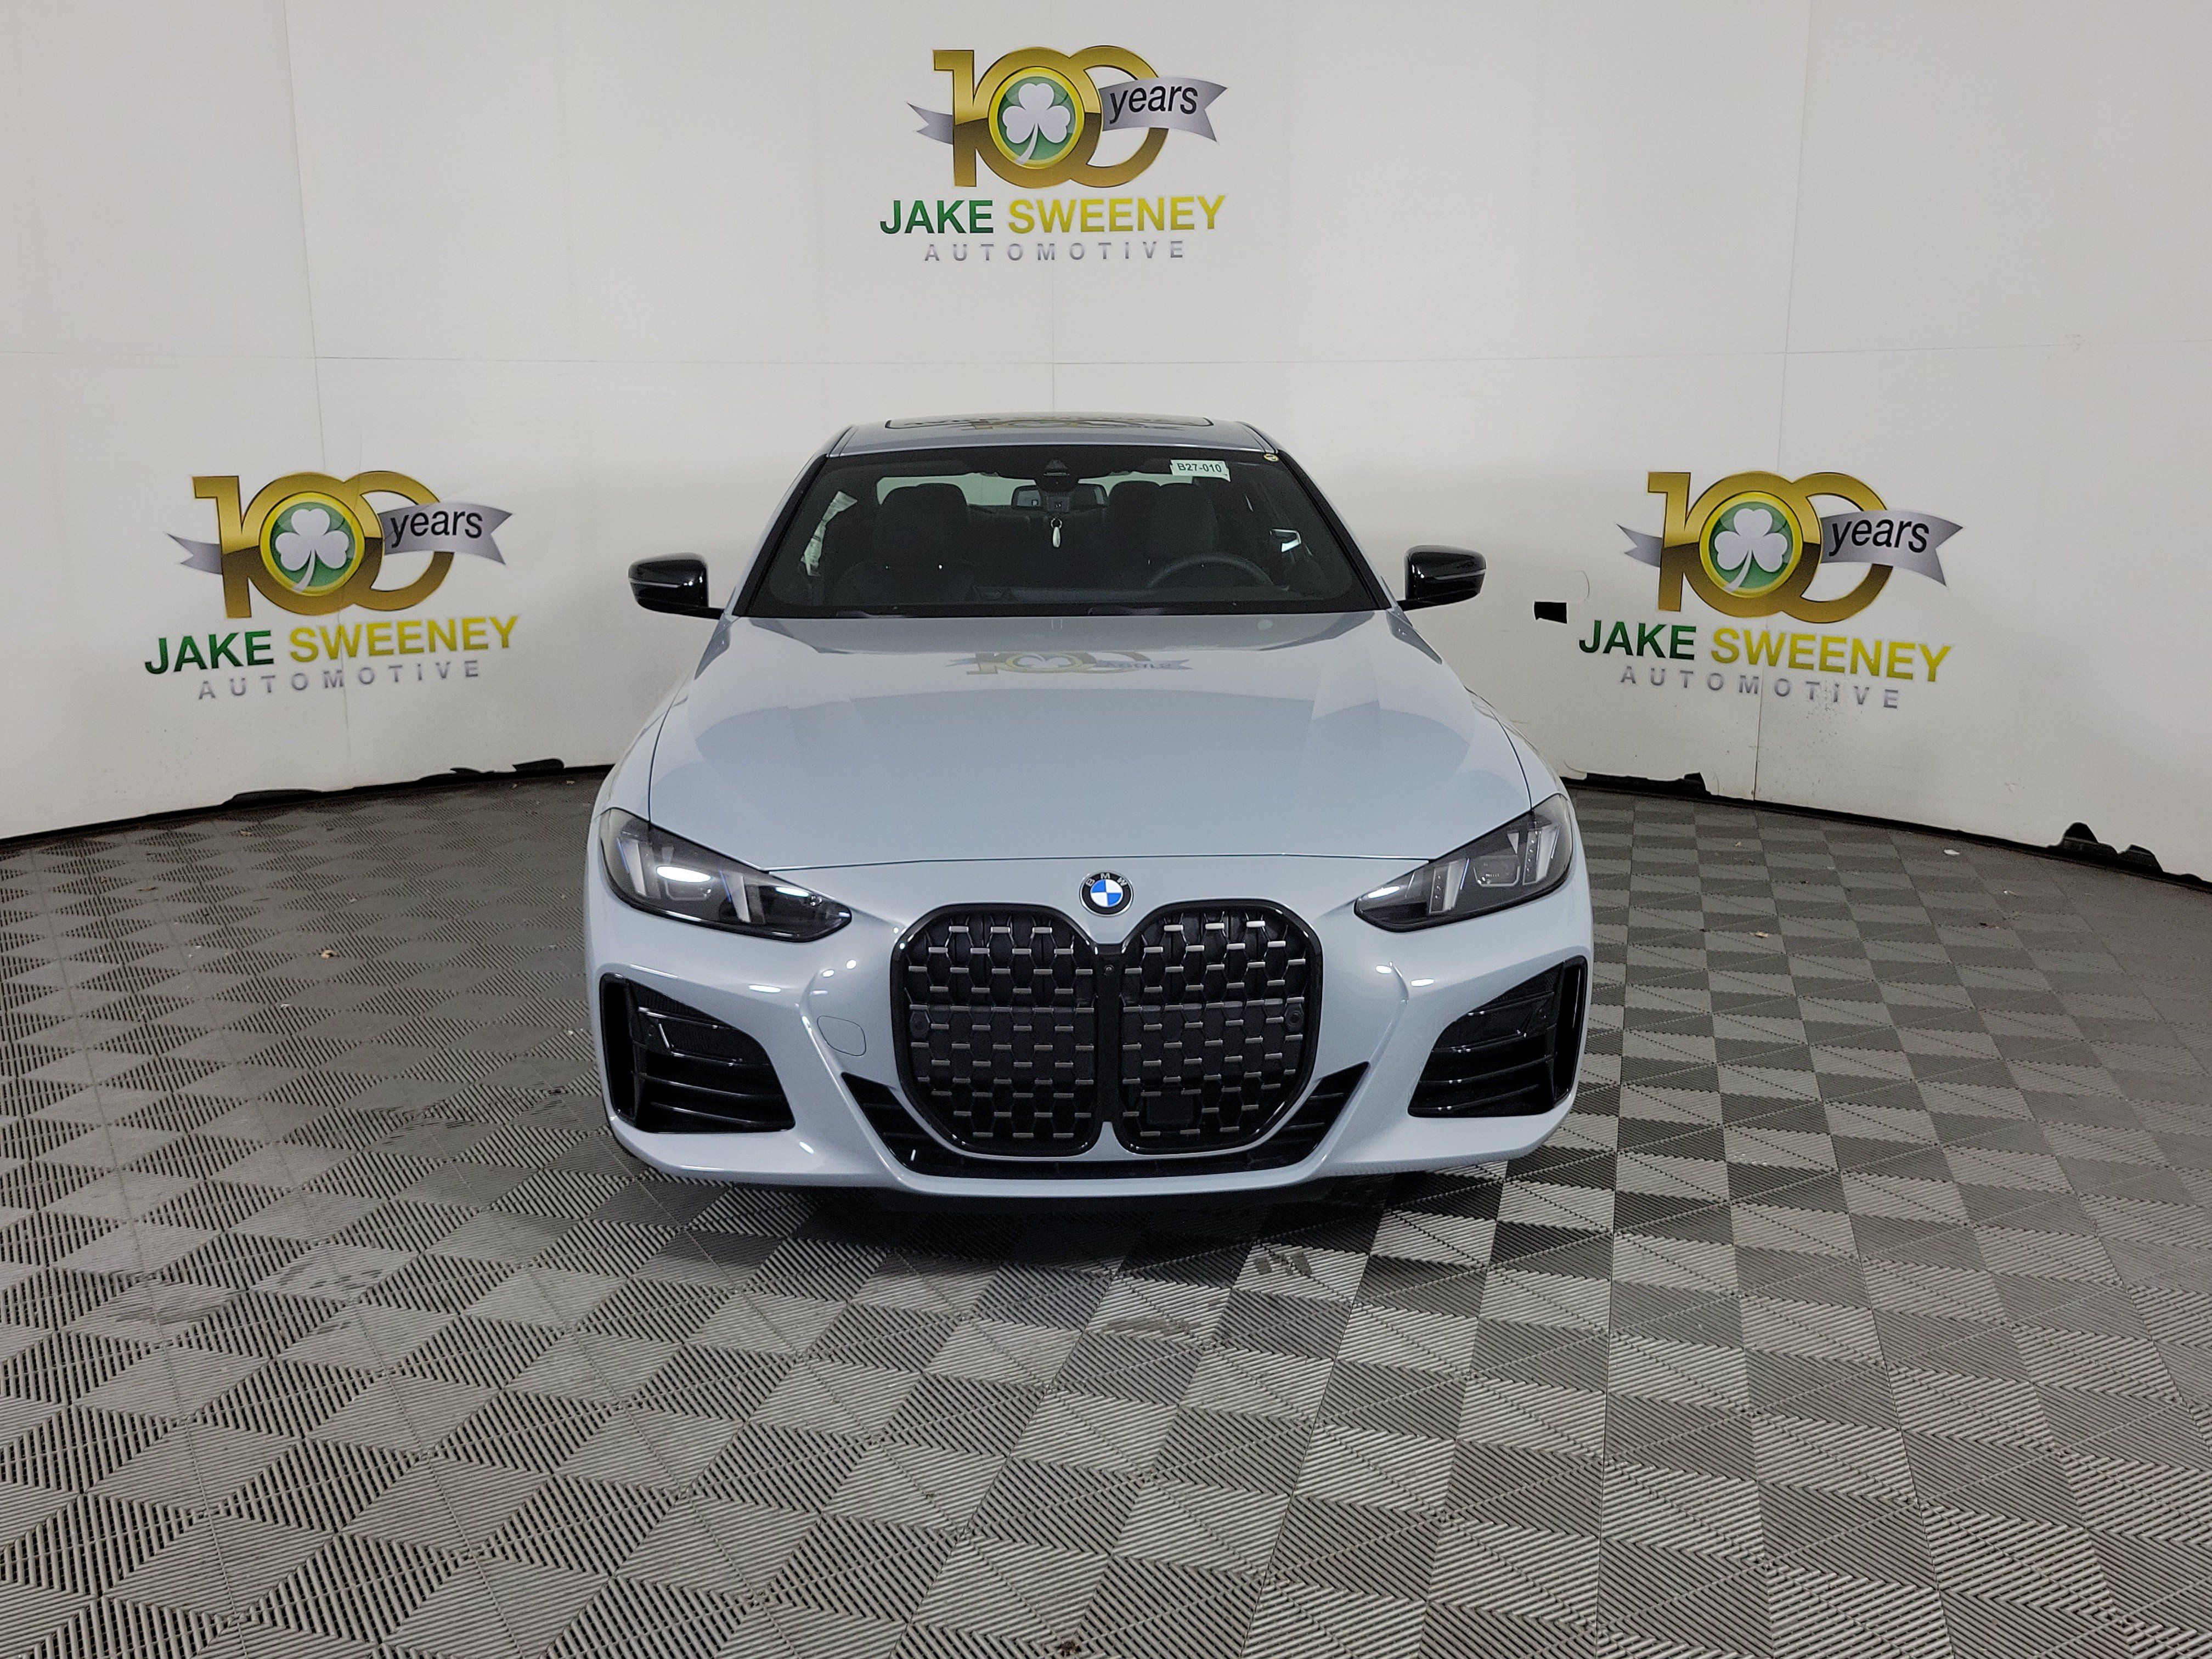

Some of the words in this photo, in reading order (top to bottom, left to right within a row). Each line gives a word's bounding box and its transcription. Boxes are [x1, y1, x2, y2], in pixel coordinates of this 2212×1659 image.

[933, 45, 1169, 189] 100
[1109, 84, 1199, 124] years
[880, 200, 994, 234] JAKE
[1008, 195, 1226, 234] SWEENEY
[924, 240, 1184, 262] AUTOMOTIVE
[1177, 462, 1222, 473] B27-010
[192, 470, 455, 619] 100
[390, 509, 484, 548] years
[1647, 470, 1893, 624] 100
[1828, 517, 1930, 557] years
[144, 630, 274, 675] JAKE
[289, 615, 519, 663] SWEENEY
[1578, 619, 1697, 661] JAKE
[1711, 627, 1952, 682] SWEENEY
[198, 660, 479, 701] AUTOMOTIVE
[1620, 666, 1899, 709] AUTOMOTIVE
[1086, 872, 1127, 887] BMW
